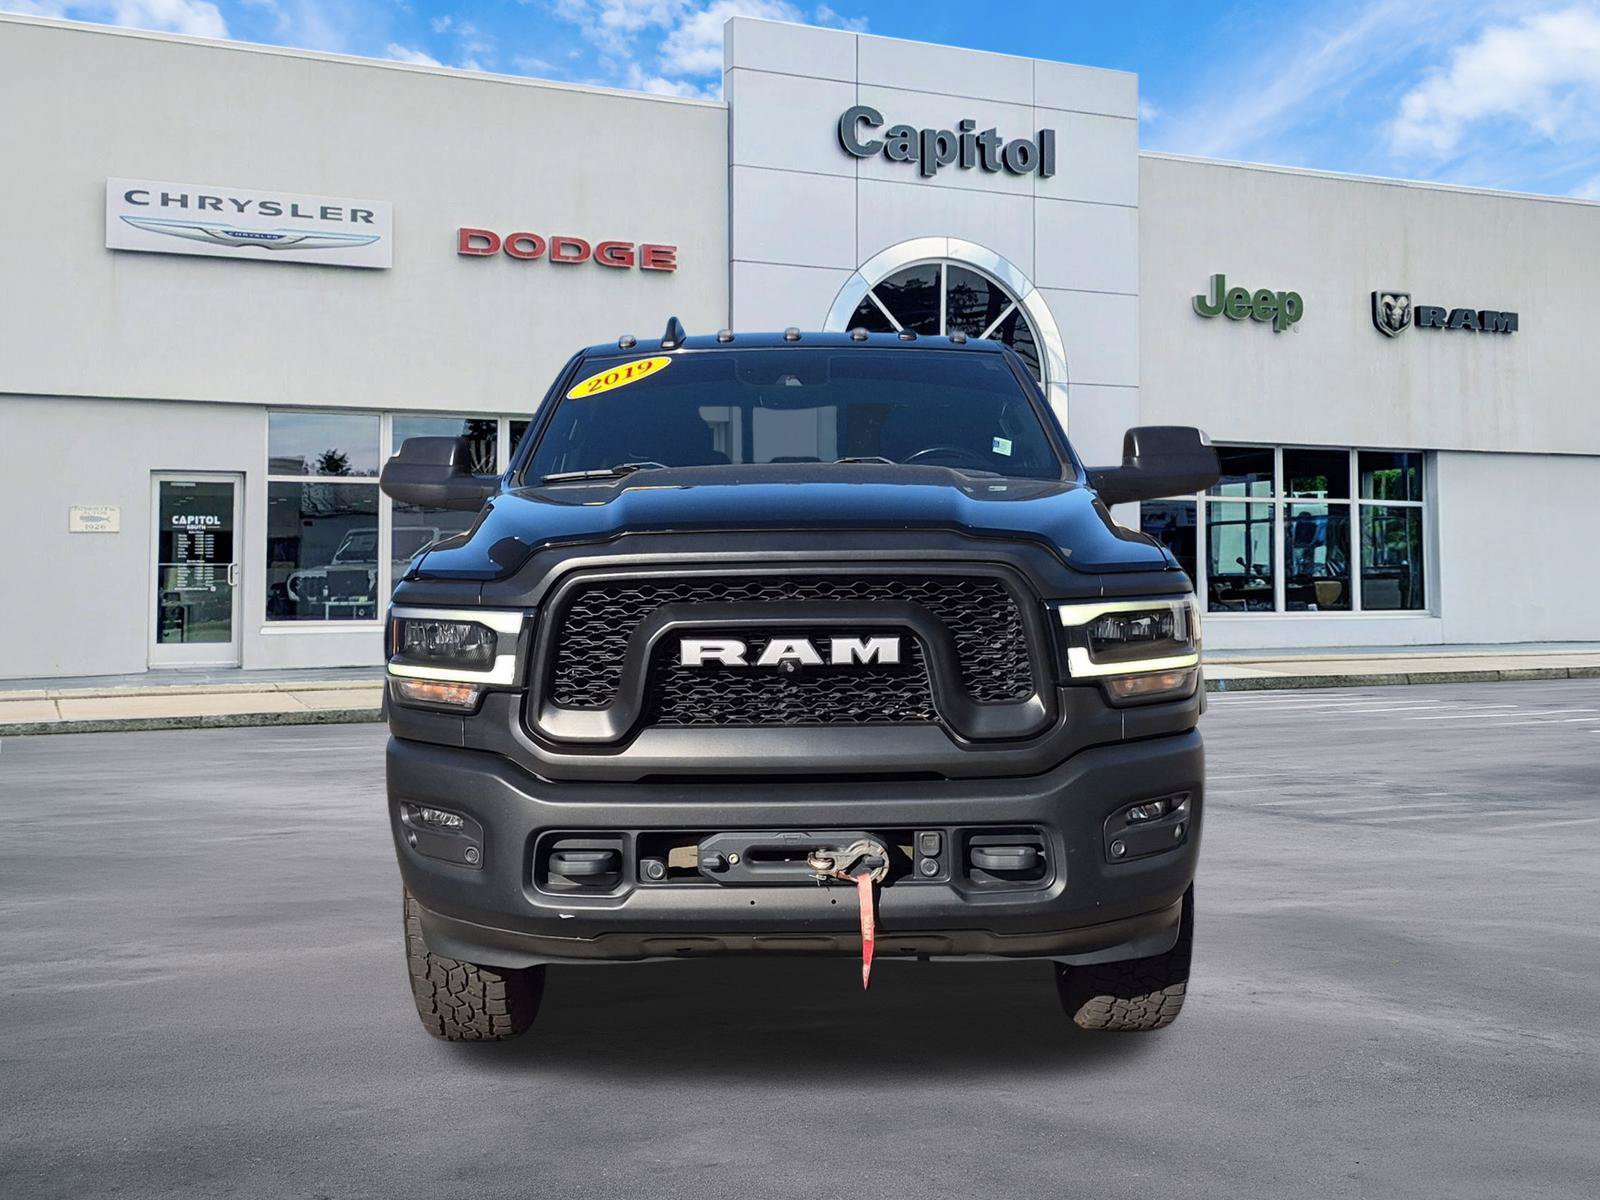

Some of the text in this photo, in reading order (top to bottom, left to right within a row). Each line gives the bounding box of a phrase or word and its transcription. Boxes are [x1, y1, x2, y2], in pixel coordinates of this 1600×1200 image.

[838, 105, 1056, 178] Capitol
[124, 189, 375, 224] CHRYSLER
[457, 227, 678, 272] DODGE
[1192, 273, 1304, 333] Jeep
[1414, 305, 1519, 333] RAM
[588, 361, 653, 393] 2019
[172, 515, 221, 525] CAPITOL
[680, 638, 900, 666] RAM
